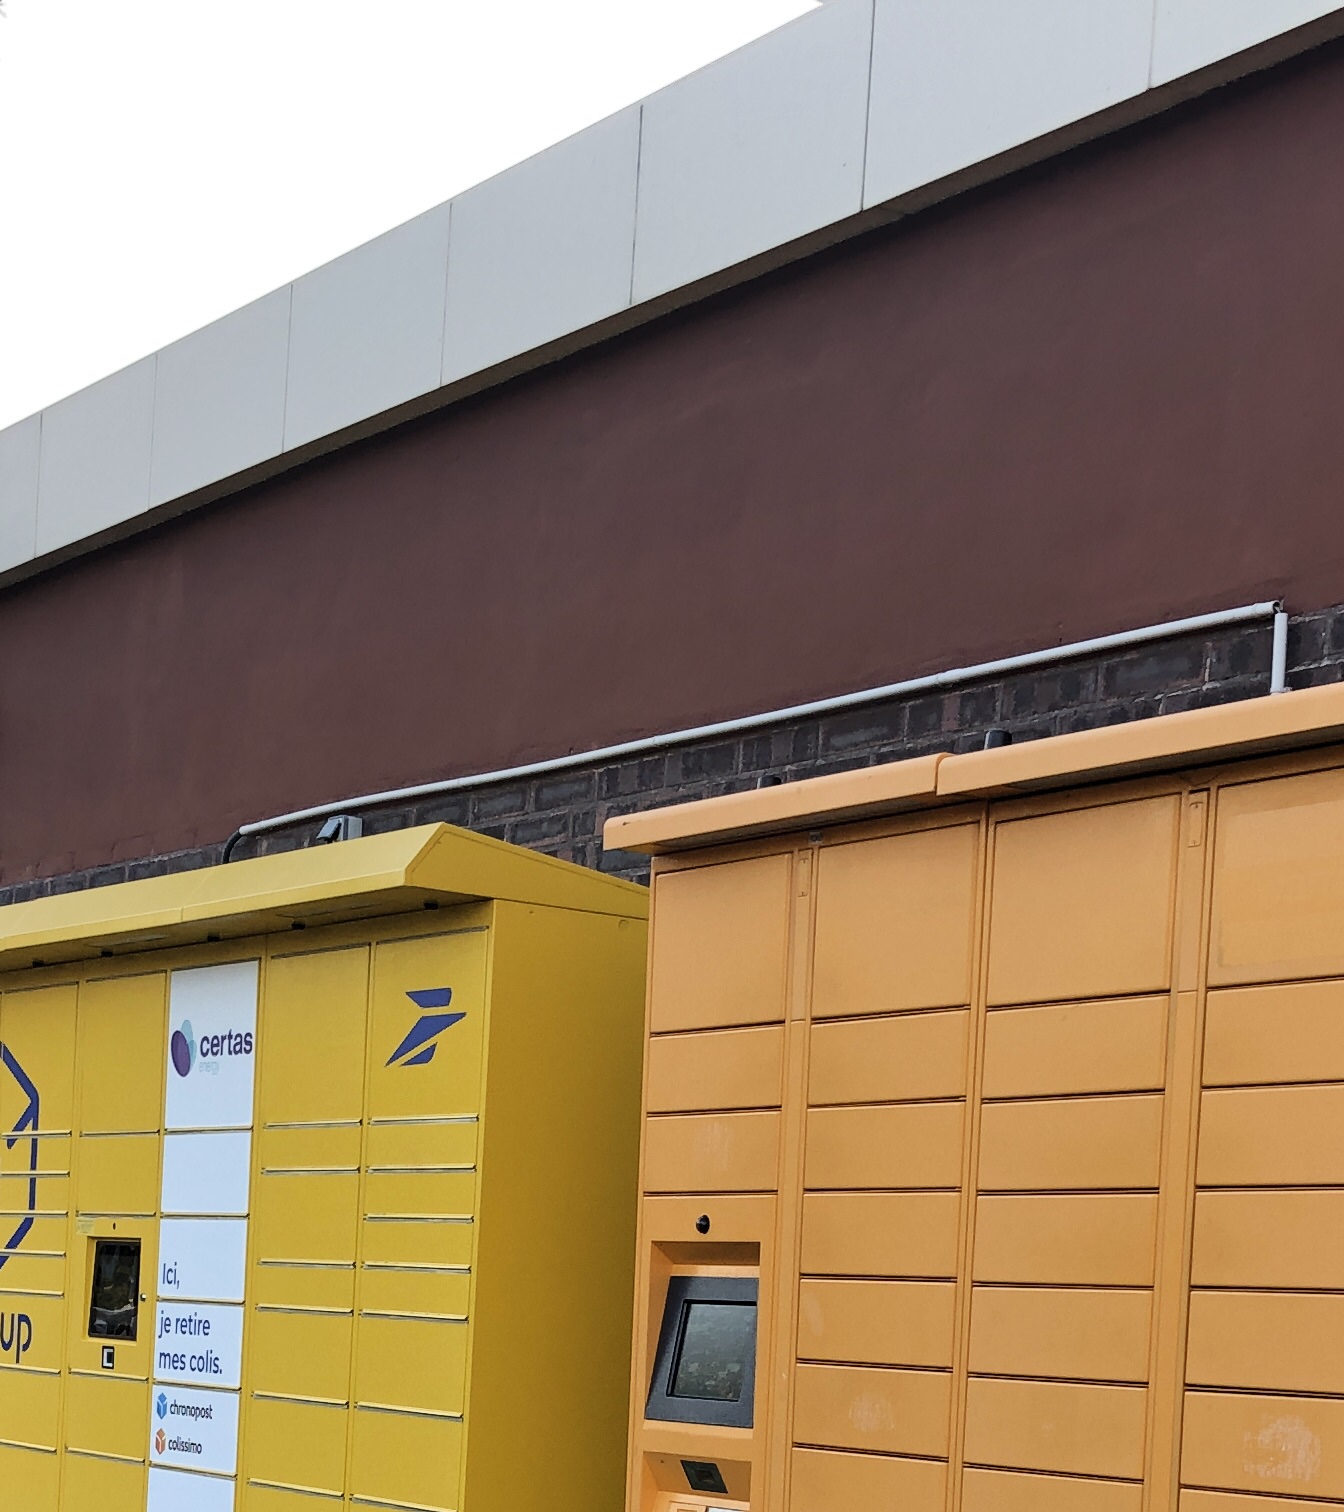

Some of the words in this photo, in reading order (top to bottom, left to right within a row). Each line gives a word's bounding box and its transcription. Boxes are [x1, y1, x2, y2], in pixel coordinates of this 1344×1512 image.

[200, 1029, 253, 1057] certas
[162, 1262, 180, 1289] Ici,
[158, 1310, 171, 1338] je
[175, 1312, 210, 1336] retire
[158, 1351, 186, 1371] mes
[189, 1350, 223, 1374] colis.
[169, 1399, 213, 1421] chronopost
[168, 1437, 202, 1455] colissimo
